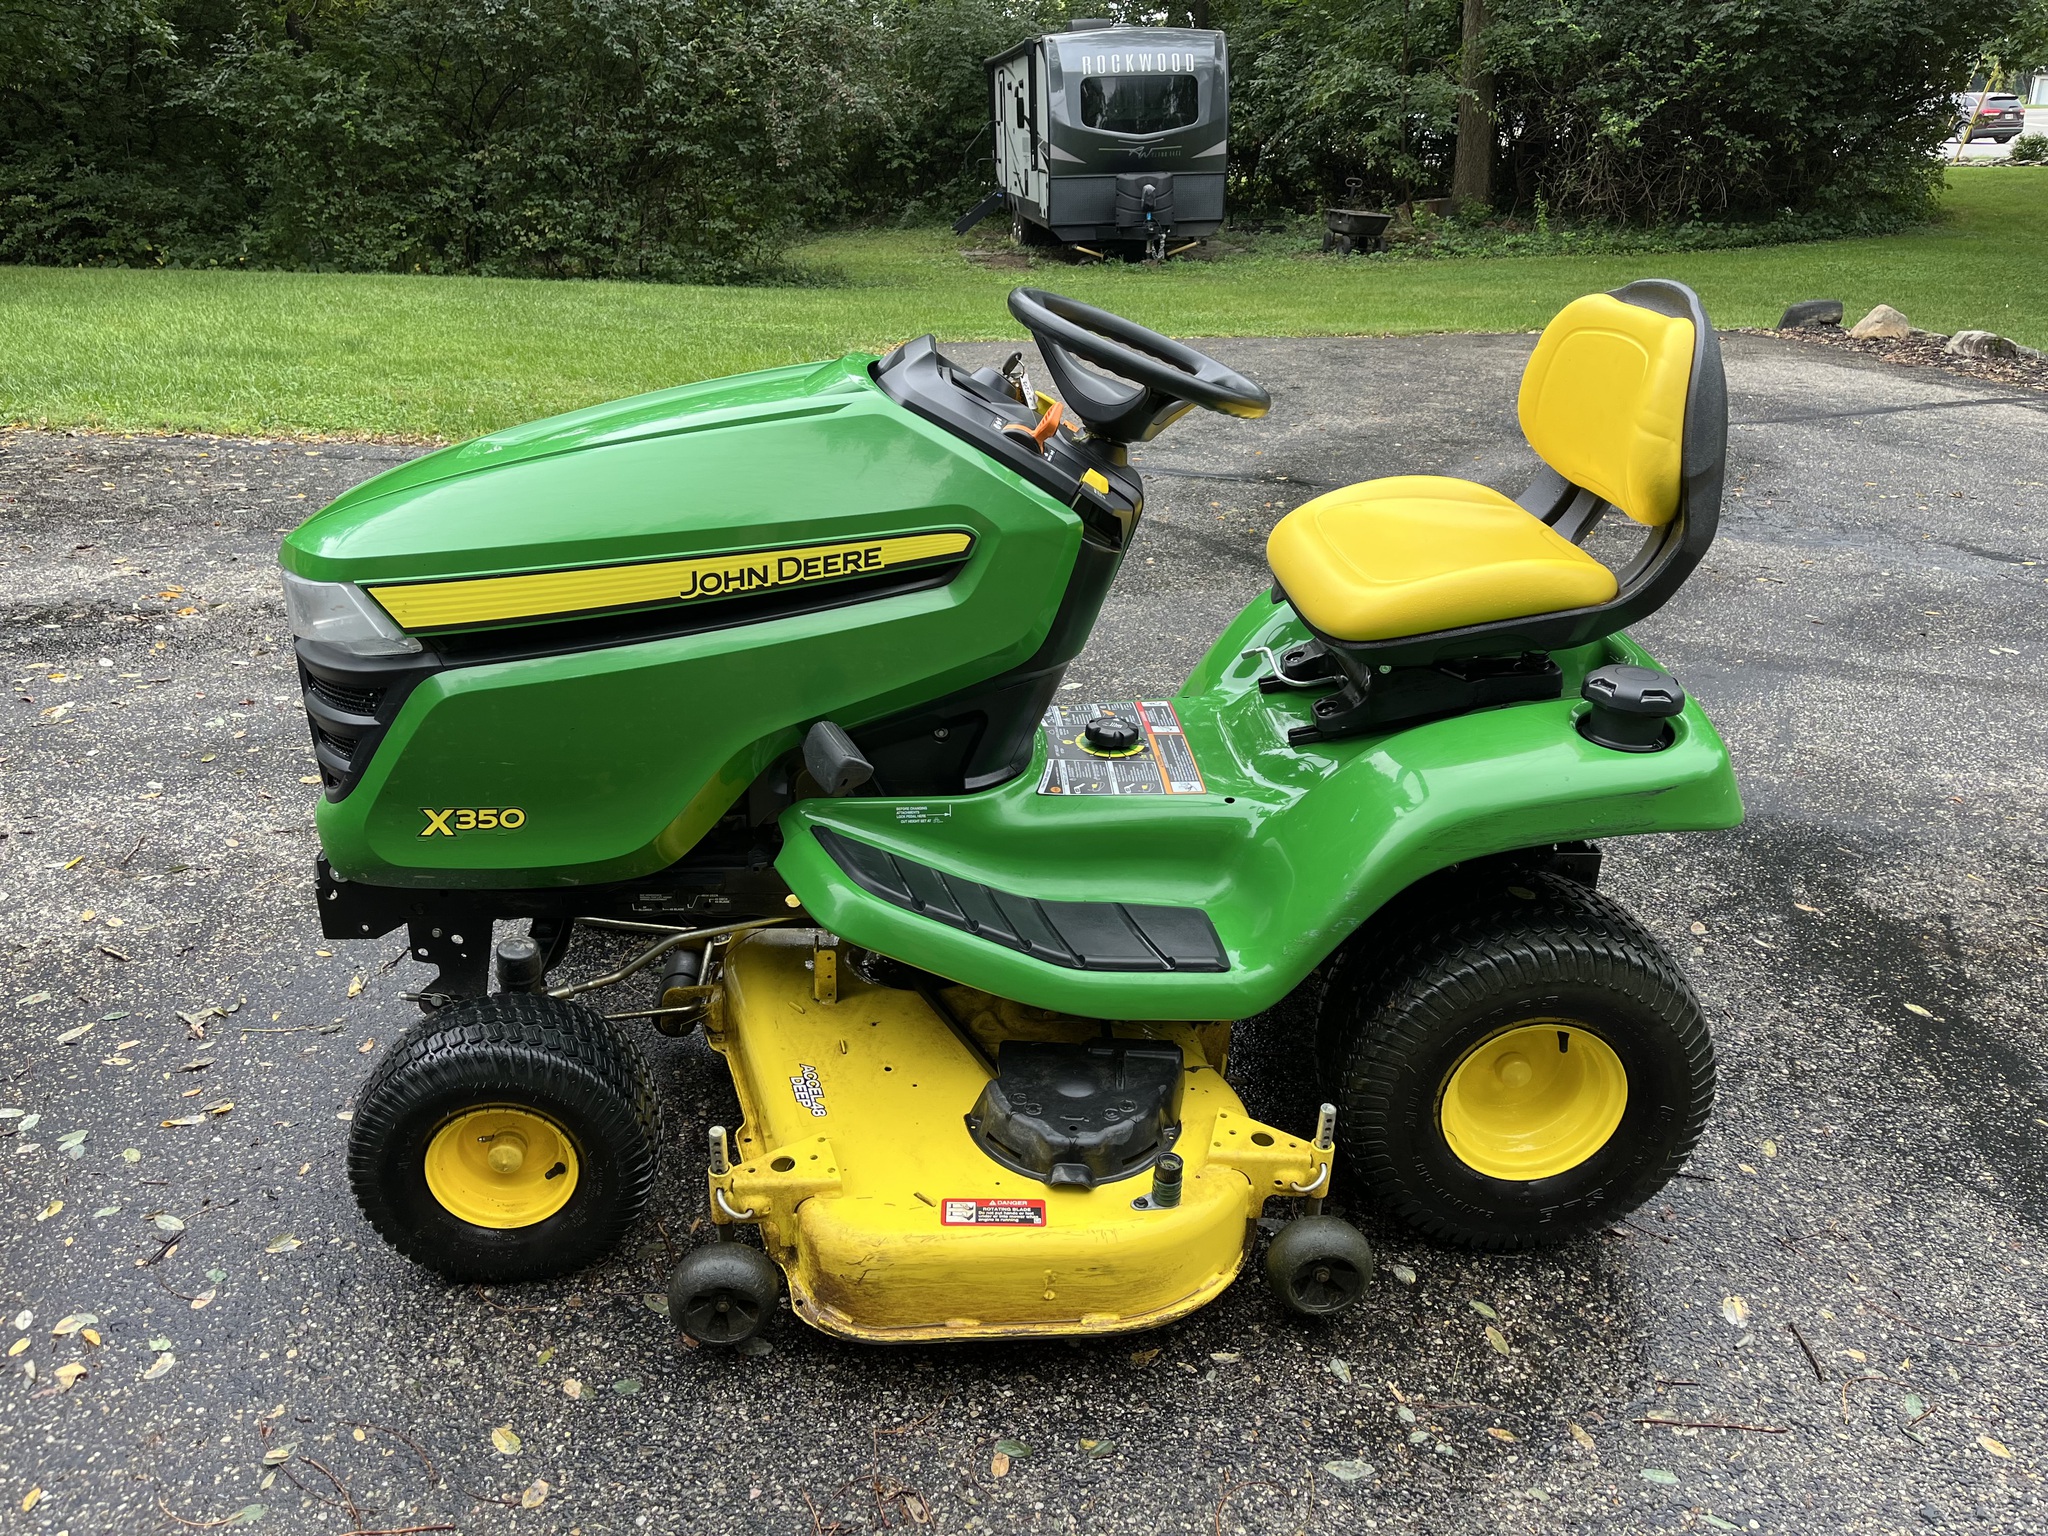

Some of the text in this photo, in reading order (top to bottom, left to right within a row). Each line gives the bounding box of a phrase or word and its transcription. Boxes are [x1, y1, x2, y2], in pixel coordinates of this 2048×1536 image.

[1082, 53, 1195, 75] ROCKWOOD
[679, 546, 884, 597] JOHN DEERE
[418, 807, 527, 837] X350
[789, 1076, 812, 1109] DEEP
